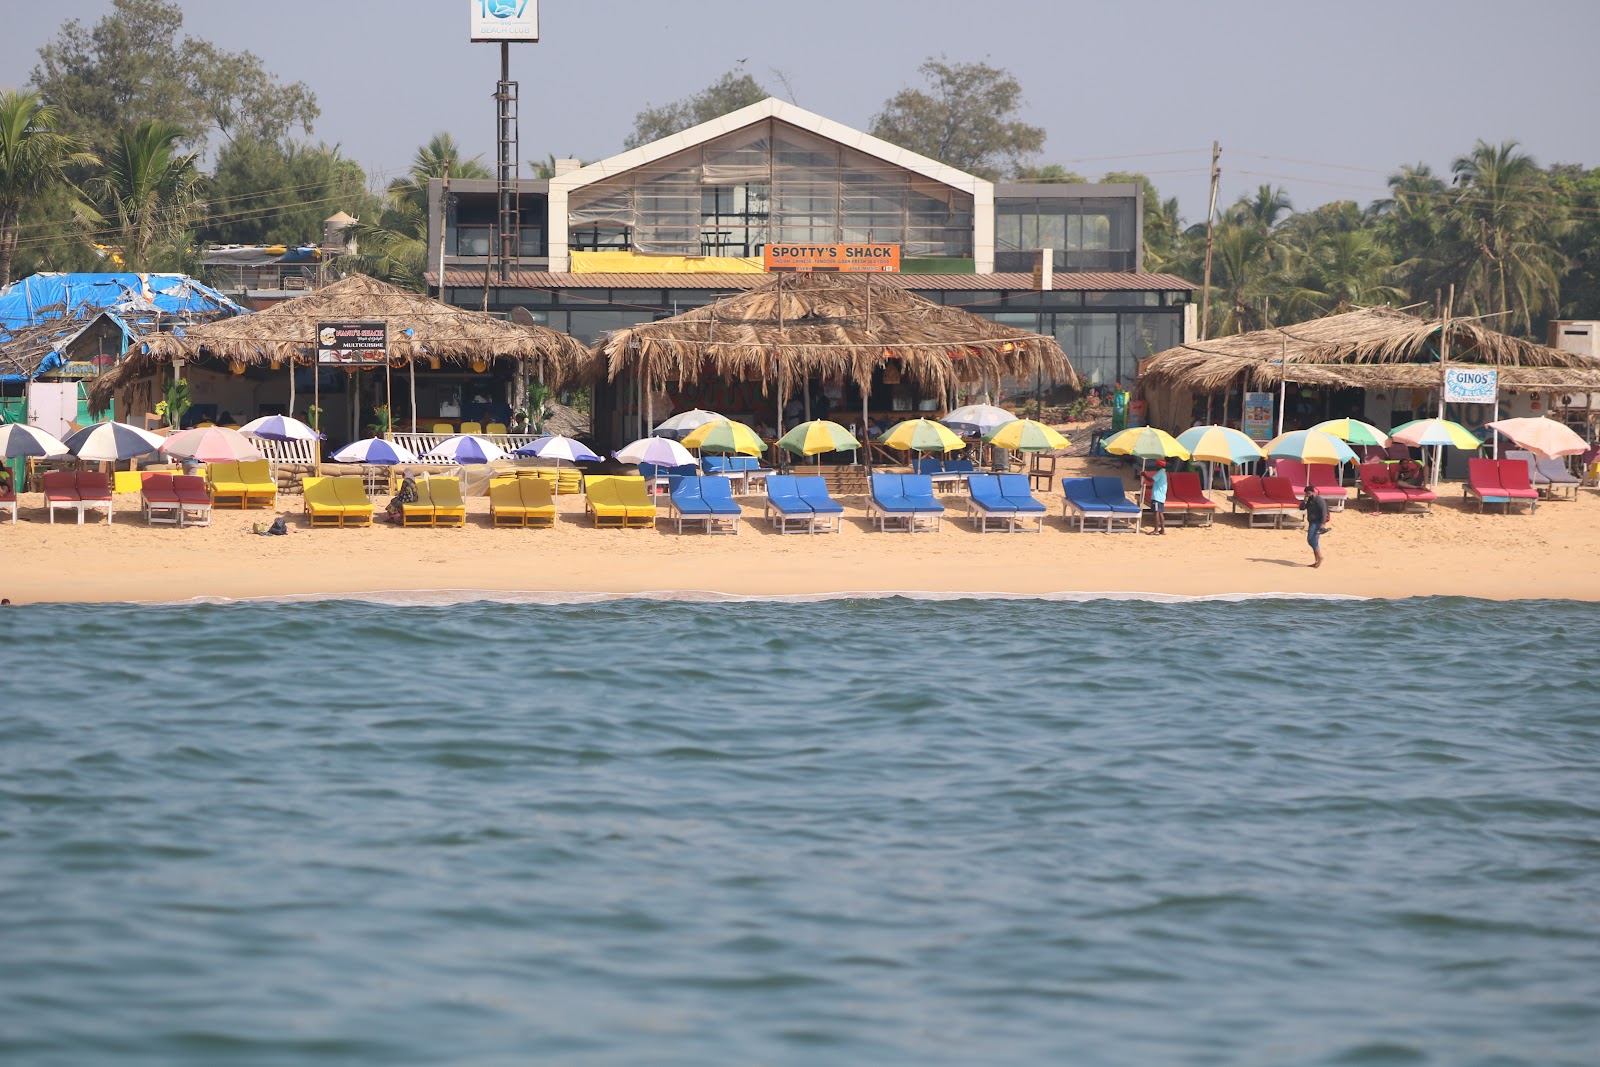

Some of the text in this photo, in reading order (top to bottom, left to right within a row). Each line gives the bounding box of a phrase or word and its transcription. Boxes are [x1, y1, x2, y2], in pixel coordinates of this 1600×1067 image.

[479, 0, 528, 18] 107
[772, 247, 892, 257] SPOTTY'S SHACK
[1456, 372, 1488, 384] GINO'S
